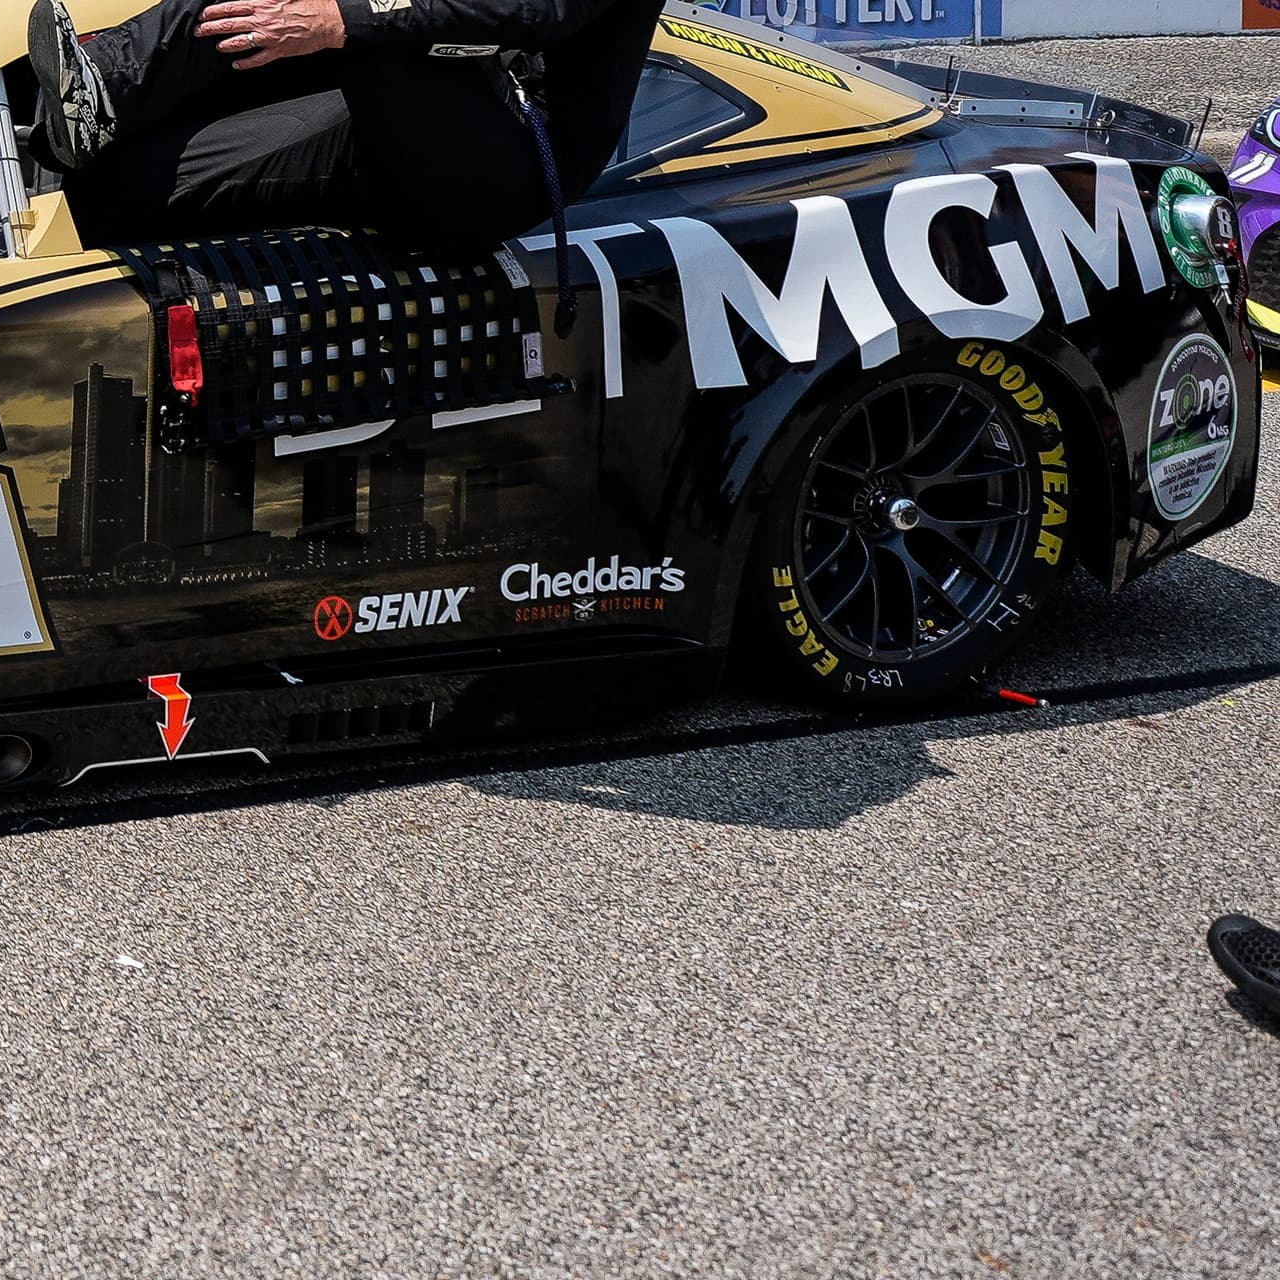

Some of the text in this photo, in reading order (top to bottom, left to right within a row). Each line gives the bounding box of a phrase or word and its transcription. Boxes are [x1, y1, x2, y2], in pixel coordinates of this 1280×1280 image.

[664, 20, 842, 87] MORGAN & MORGAN
[1159, 373, 1230, 429] zone
[957, 341, 1069, 566] GOODYEAR
[500, 554, 686, 602] Cheddar's
[354, 586, 471, 634] SENIX
[515, 596, 665, 622] SCRATCH KITCHEN
[772, 565, 839, 677] EAGLE
